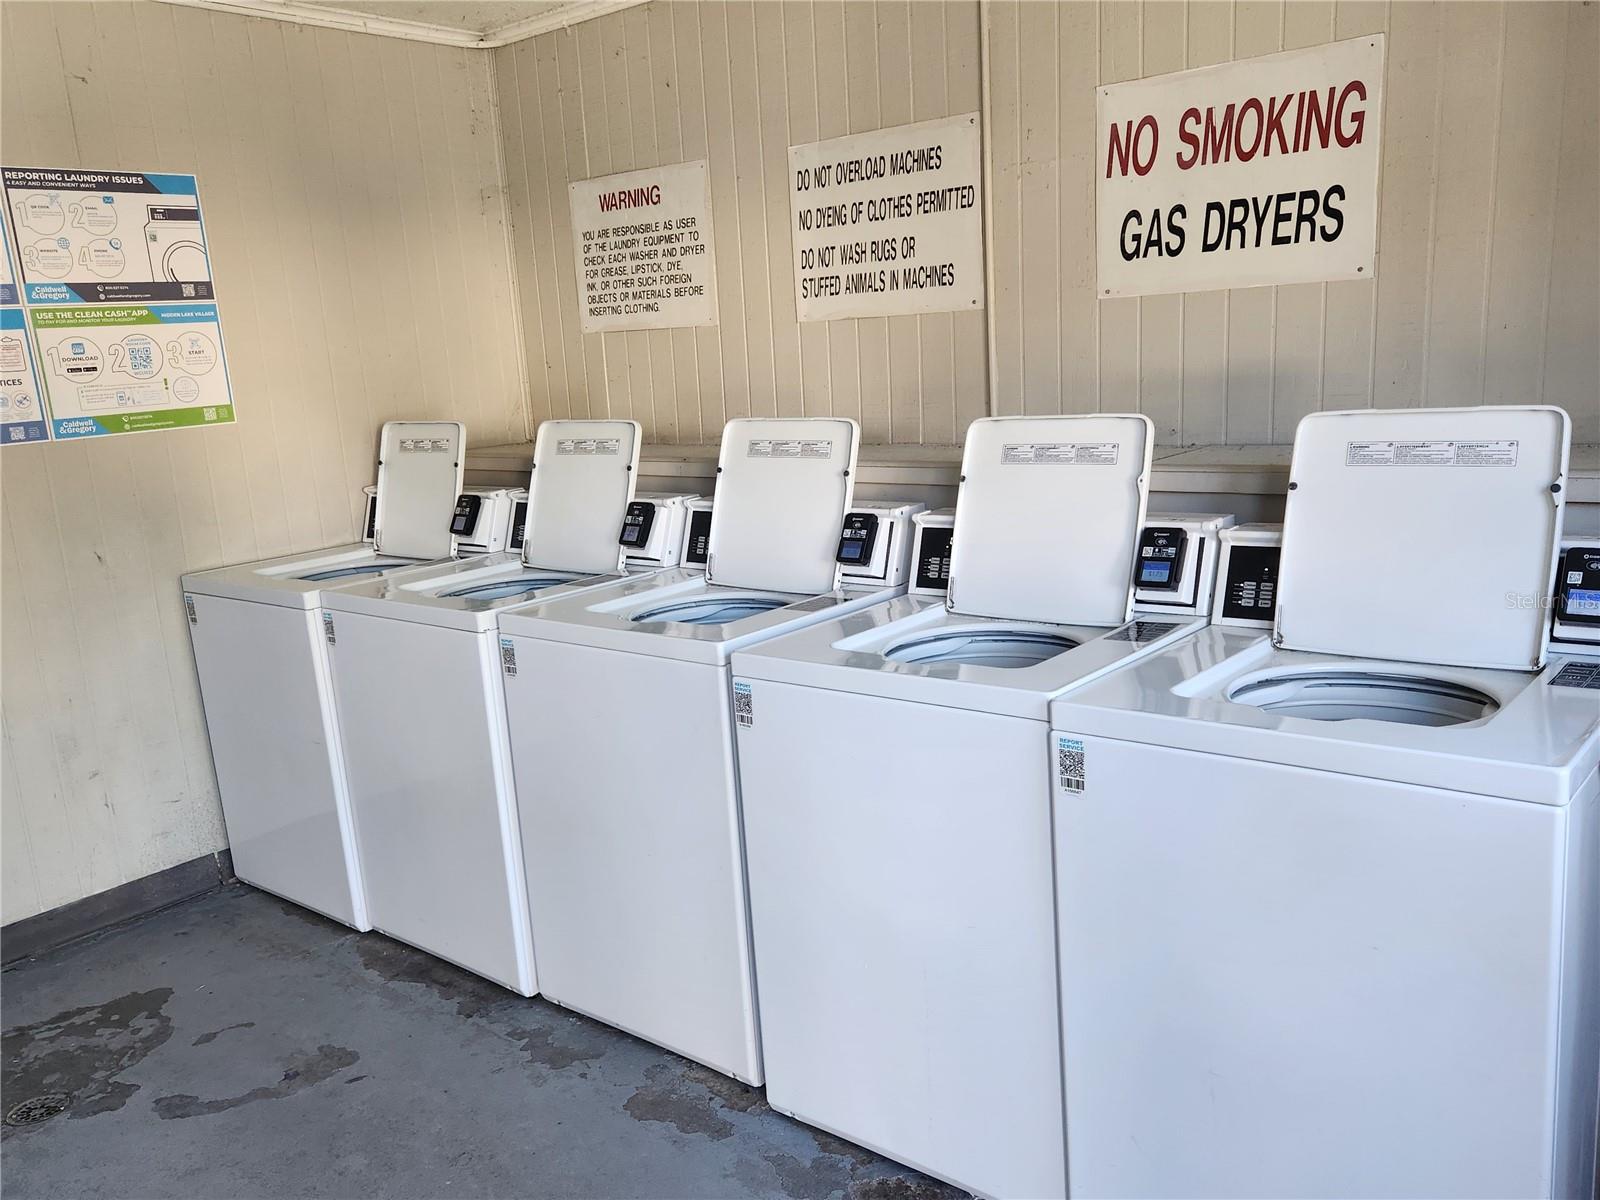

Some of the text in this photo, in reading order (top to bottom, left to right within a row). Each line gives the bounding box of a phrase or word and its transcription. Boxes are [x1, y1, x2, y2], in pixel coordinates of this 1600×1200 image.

[1106, 80, 1366, 179] NO SMOKING
[5, 172, 144, 184] REPORTING LAUNDRY ISSUES
[797, 145, 942, 191] DO NOT OVERLOAD MACHINES
[599, 185, 660, 212] WARNING
[799, 185, 974, 230] NO DYEING OF CLOTHES PERMITTED
[582, 217, 696, 241] YOU ARE RESPONSIBLE AS USER
[1120, 184, 1346, 262] GAS DRYERS
[583, 231, 699, 254] OF THE LAUNDRY EQUIPMENT TO
[802, 236, 915, 270] DO NOT WASH RUGS OR
[584, 244, 705, 266] CHECK EACH WASHER AND DRYER
[586, 270, 598, 279] FOR
[601, 266, 628, 277] GREASE,
[631, 263, 664, 274] LIPSTICK,
[601, 281, 610, 290] OR
[613, 279, 634, 289] OTHER
[638, 277, 657, 287] SUCH
[660, 274, 692, 285] FOREIGN
[802, 263, 954, 299] STUFFED ANIMALS IN MACHINES
[588, 286, 703, 304] OBJECTS OR MATERIALS BEFORE
[589, 302, 660, 316] INSERTING CLOTHING.
[1059, 743, 1084, 751] SERVICE
[1060, 737, 1083, 745] REPORT
